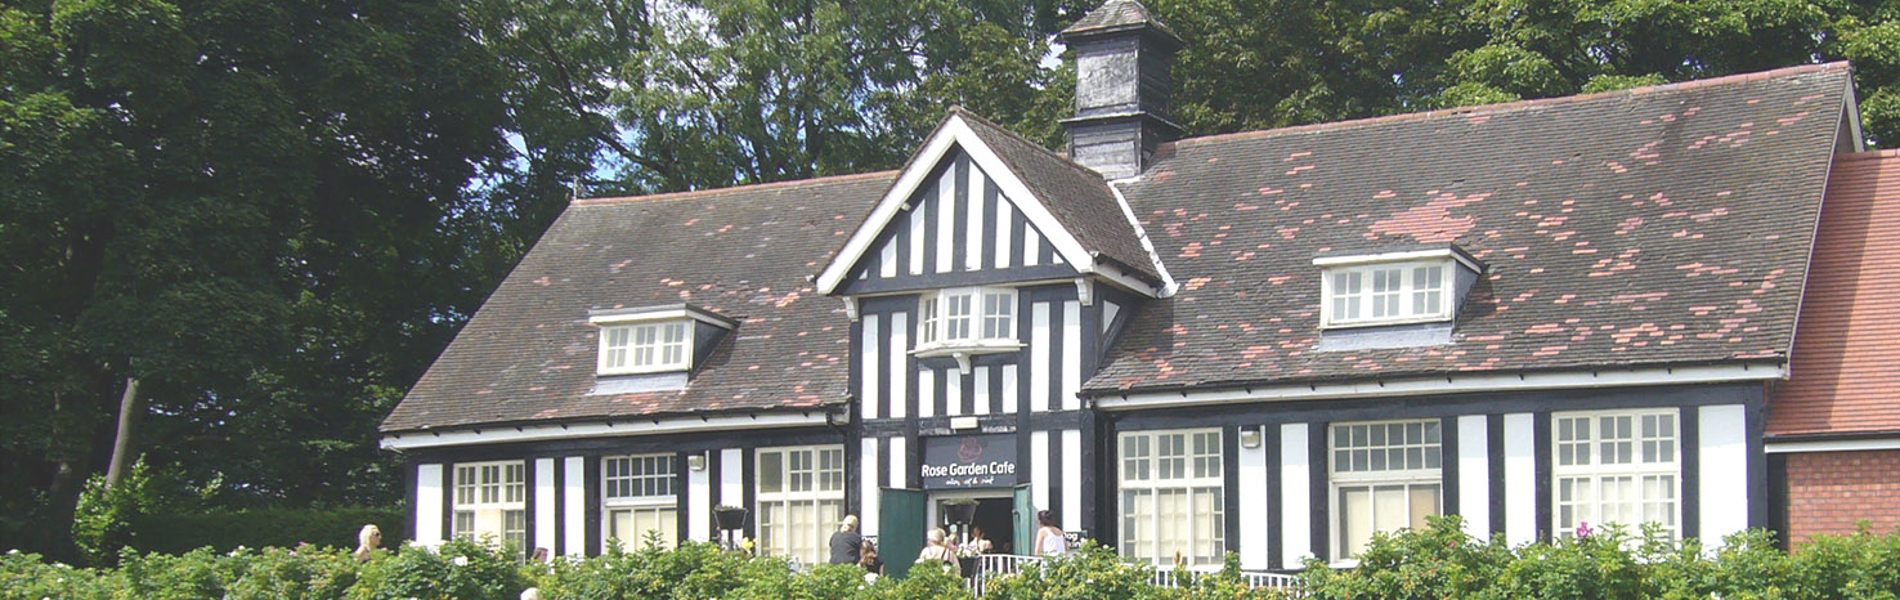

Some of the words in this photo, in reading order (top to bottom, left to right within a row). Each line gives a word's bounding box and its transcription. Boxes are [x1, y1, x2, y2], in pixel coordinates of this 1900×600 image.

[921, 464, 948, 477] Rose
[949, 462, 988, 476] Garden
[989, 461, 1015, 475] Cafe
